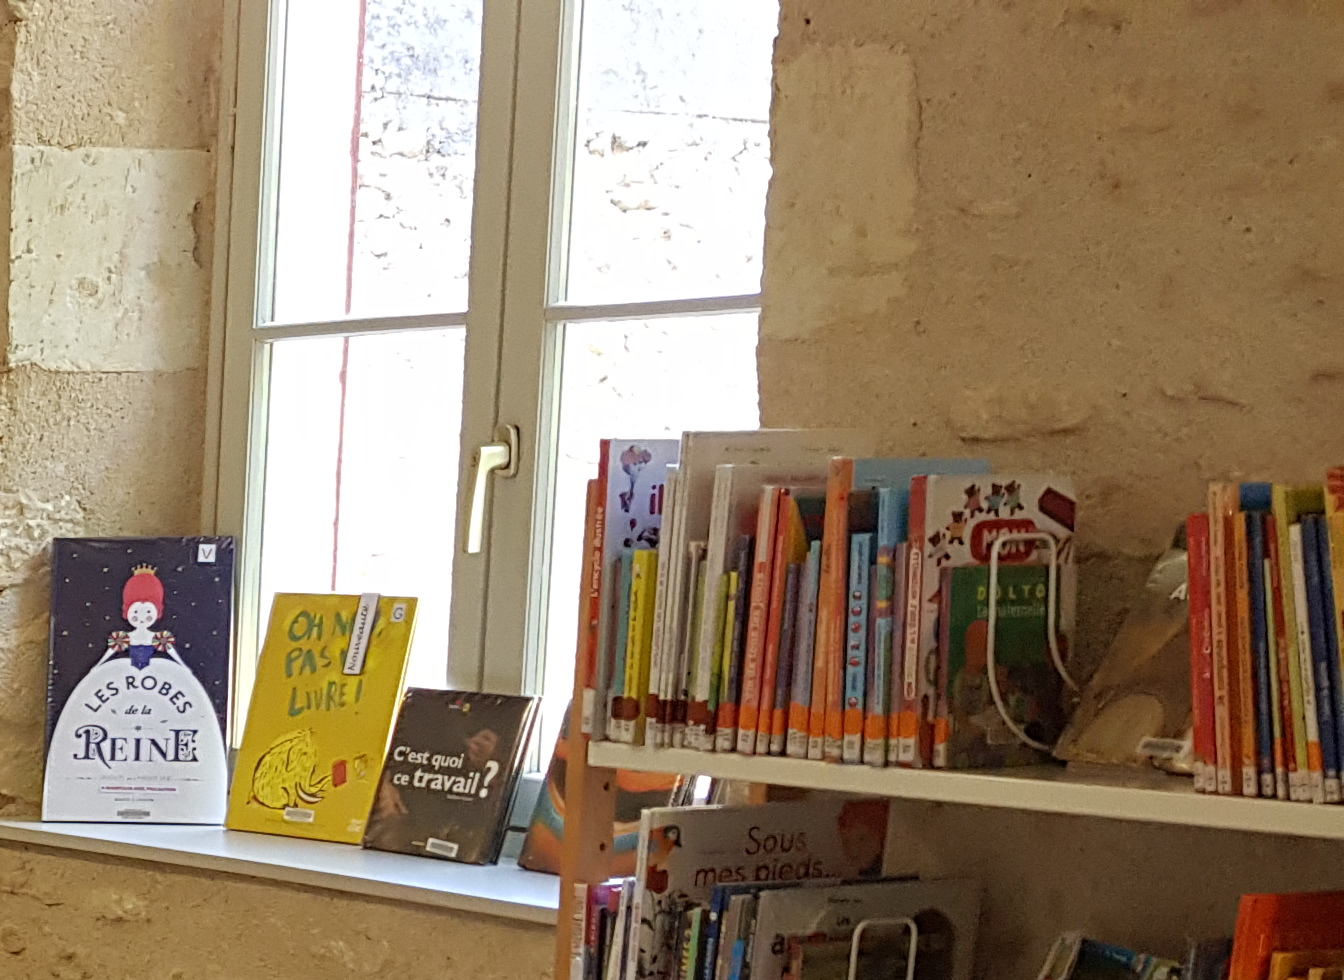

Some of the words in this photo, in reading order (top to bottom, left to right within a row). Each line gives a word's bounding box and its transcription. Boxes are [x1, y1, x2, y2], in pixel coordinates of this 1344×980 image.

[201, 546, 213, 560] V
[288, 610, 324, 642] OH
[393, 607, 404, 620] G
[285, 645, 332, 678] PAS
[85, 681, 120, 713] LES
[125, 676, 193, 714] ROBES
[124, 705, 139, 715] de
[141, 705, 152, 715] la
[73, 724, 200, 770] REINE
[394, 745, 430, 765] C'est
[432, 753, 465, 770] quoi
[393, 773, 410, 785] ce
[413, 768, 481, 795] travail
[479, 760, 500, 799] ?
[745, 825, 807, 856] Sous
[695, 864, 748, 887] mes
